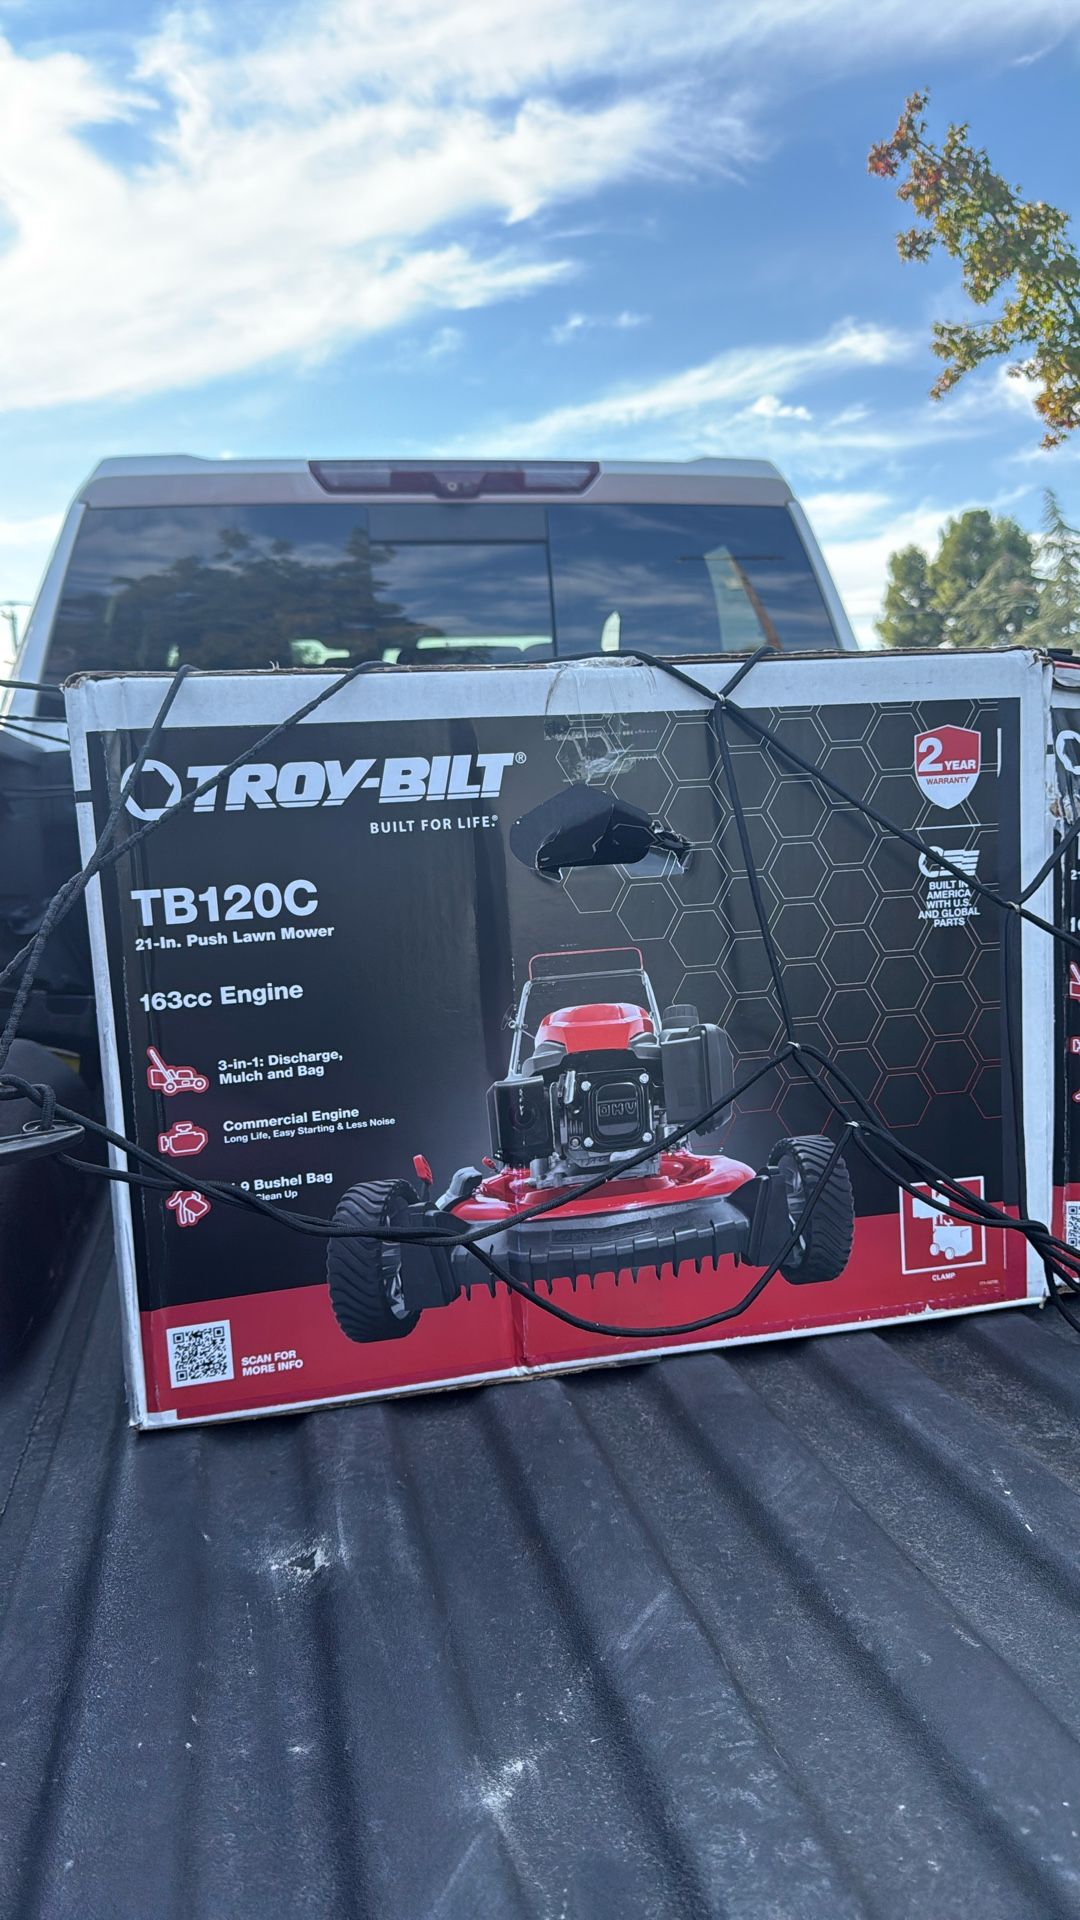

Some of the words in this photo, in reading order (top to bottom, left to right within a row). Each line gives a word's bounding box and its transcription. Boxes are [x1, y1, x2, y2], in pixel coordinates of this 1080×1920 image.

[918, 737, 943, 772] 2
[944, 759, 976, 770] YEAR
[926, 776, 970, 785] WARRANTY
[369, 820, 415, 834] BUILT
[420, 818, 452, 831] FOR
[926, 888, 972, 900] AMERICA
[928, 880, 957, 891] BUILT
[131, 879, 318, 927] TB120C
[926, 899, 951, 909] WITH
[953, 898, 972, 908] U.S.
[918, 909, 940, 919] AND
[941, 907, 981, 918] GLOBAL
[933, 917, 966, 928] PARTS
[135, 936, 181, 951] 21-In.
[187, 932, 228, 947] Push
[233, 929, 276, 944] Lawn
[281, 926, 335, 940] Mower
[140, 991, 213, 1012] 163cc
[220, 983, 304, 1006] Engine
[218, 1057, 264, 1071] 3-in-1:
[268, 1051, 343, 1066] Discharge,
[219, 1070, 263, 1085] Mulch
[267, 1067, 293, 1080] and
[298, 1065, 325, 1077] Bag
[223, 1112, 308, 1132] Commercial
[312, 1108, 360, 1123] Engine
[223, 1135, 248, 1144] Long
[250, 1131, 271, 1142] Life,
[273, 1128, 296, 1139] Easy
[298, 1123, 335, 1136] Starting
[336, 1122, 344, 1131] &
[346, 1120, 368, 1130] Less
[369, 1117, 396, 1127] Noise
[254, 1174, 302, 1191] Bushel
[306, 1172, 333, 1184] Bag
[284, 1190, 298, 1199] Up
[931, 1272, 956, 1281] CLAMP
[241, 1353, 272, 1366] SCAN
[274, 1349, 297, 1362] FOR
[242, 1363, 276, 1377] MORE
[277, 1359, 304, 1372] INFO
